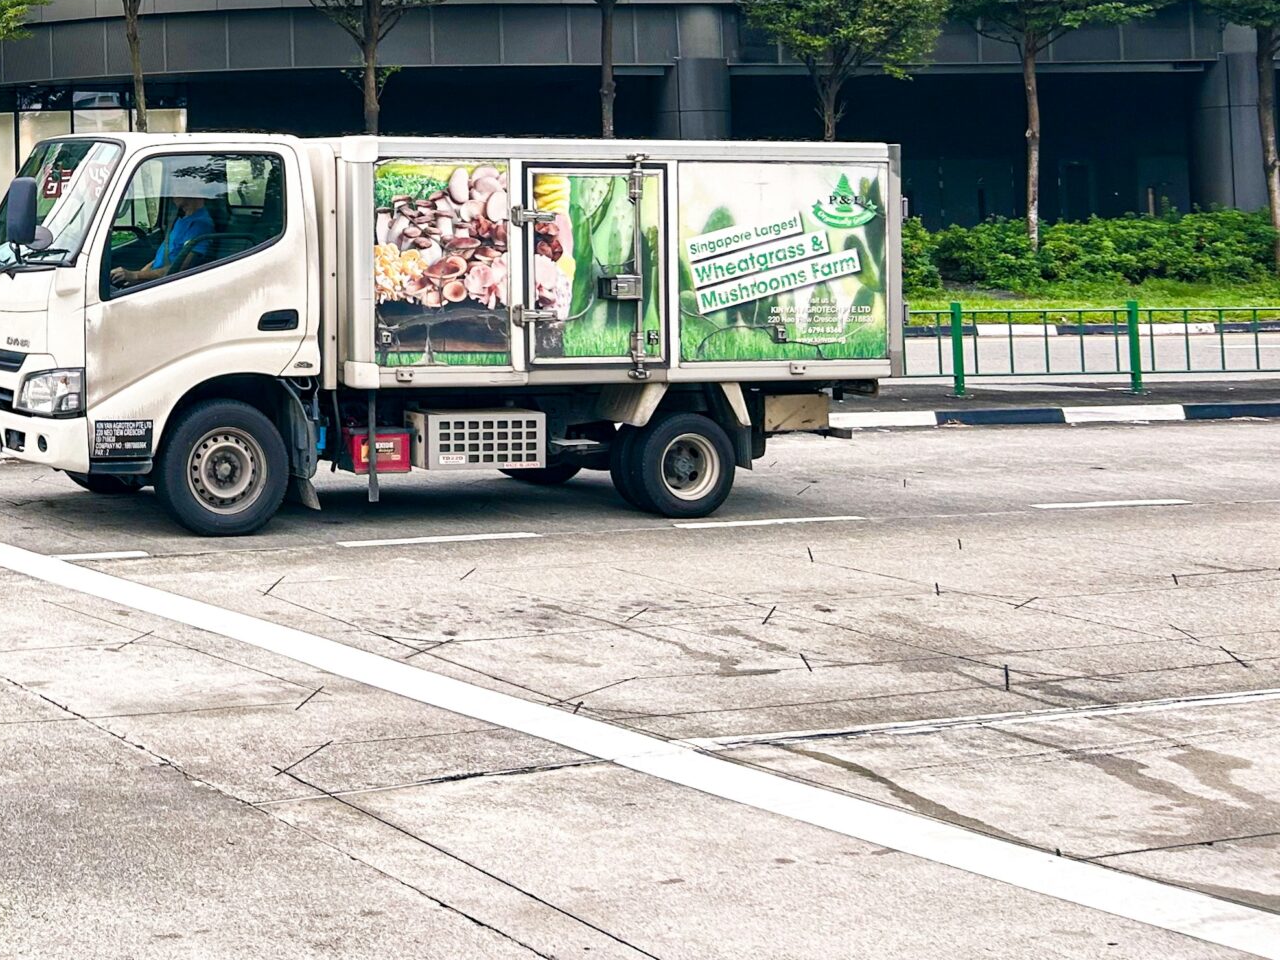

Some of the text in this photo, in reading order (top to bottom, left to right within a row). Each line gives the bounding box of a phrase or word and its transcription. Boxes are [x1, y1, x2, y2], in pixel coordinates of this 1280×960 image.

[829, 196, 837, 205] P
[839, 196, 851, 205] &
[690, 216, 799, 255] Singapore Largest
[694, 235, 824, 283] Wheatgrass &
[700, 256, 857, 309] Mushrooms Farm
